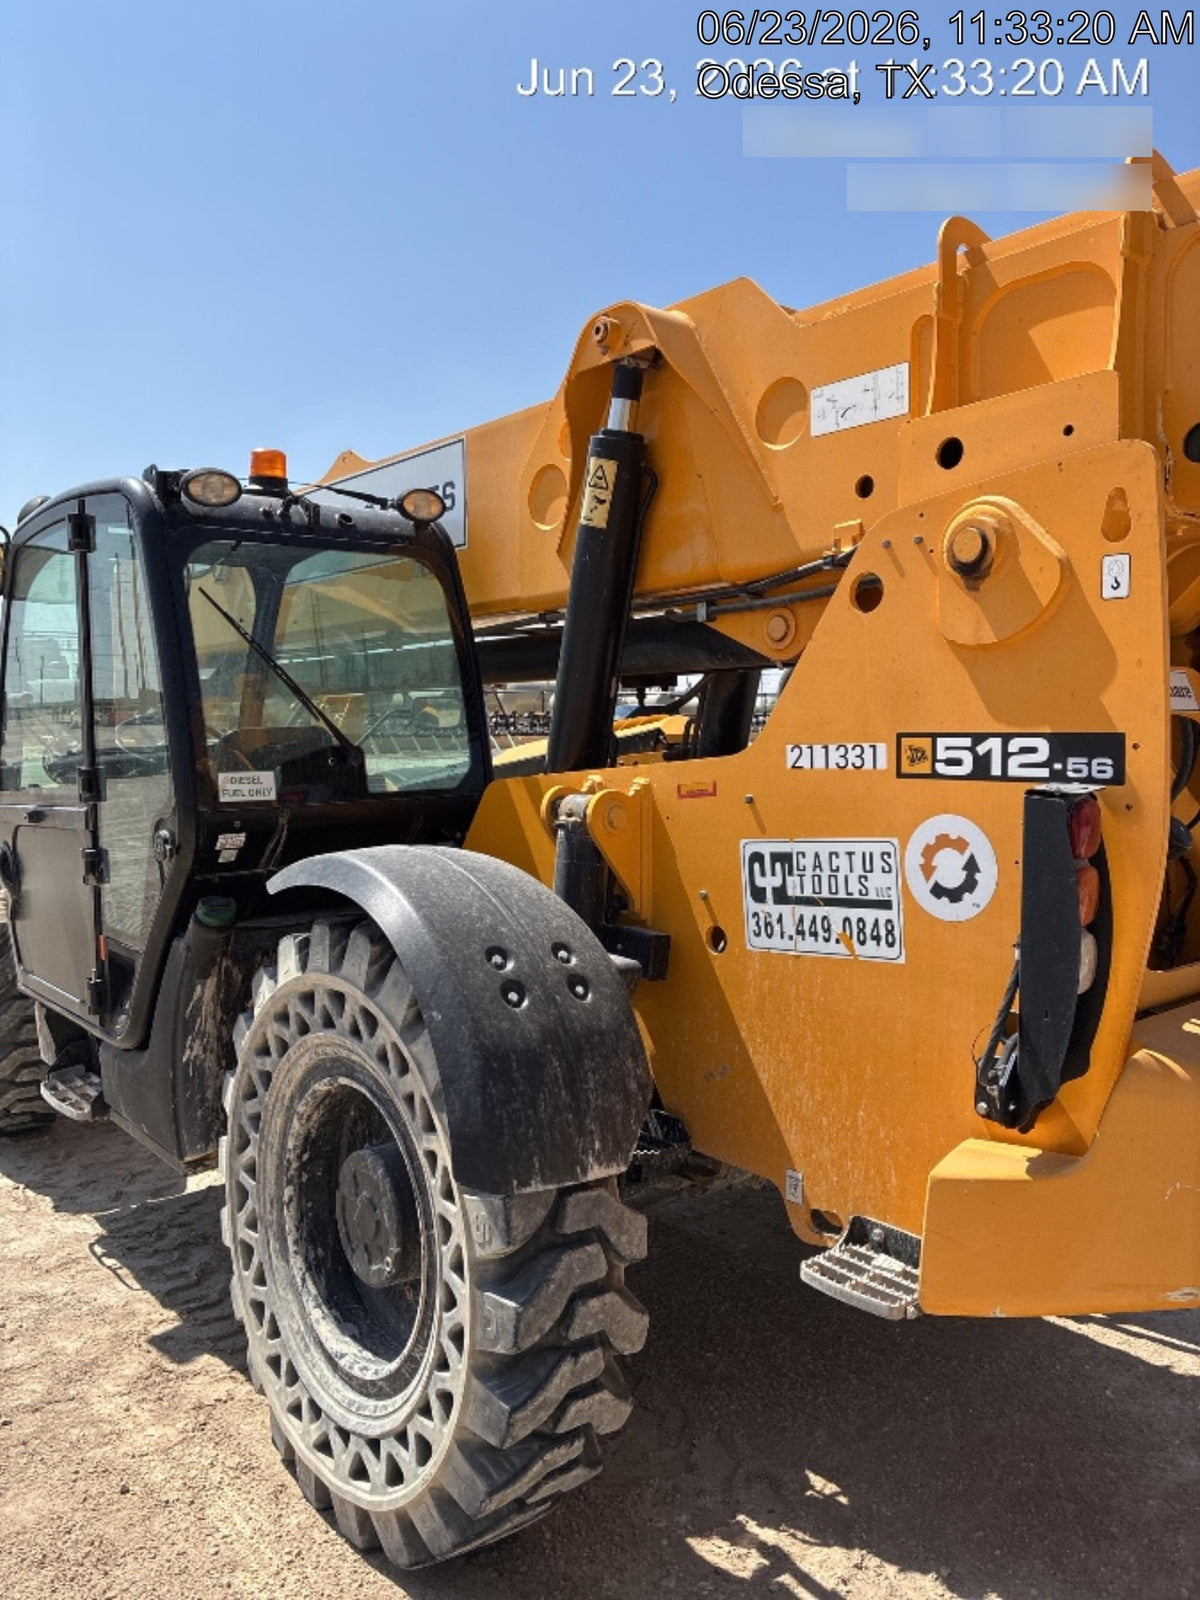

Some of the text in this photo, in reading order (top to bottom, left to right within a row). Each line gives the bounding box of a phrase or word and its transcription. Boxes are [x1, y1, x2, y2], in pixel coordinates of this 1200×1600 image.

[790, 744, 878, 769] 211331
[934, 737, 1114, 779] 512-56
[230, 776, 264, 785] DIESEL
[248, 787, 273, 797] ONLY
[796, 851, 892, 873] CACTUS
[796, 874, 892, 898] TOOLS LLC
[752, 911, 896, 948] 361.449.0848
